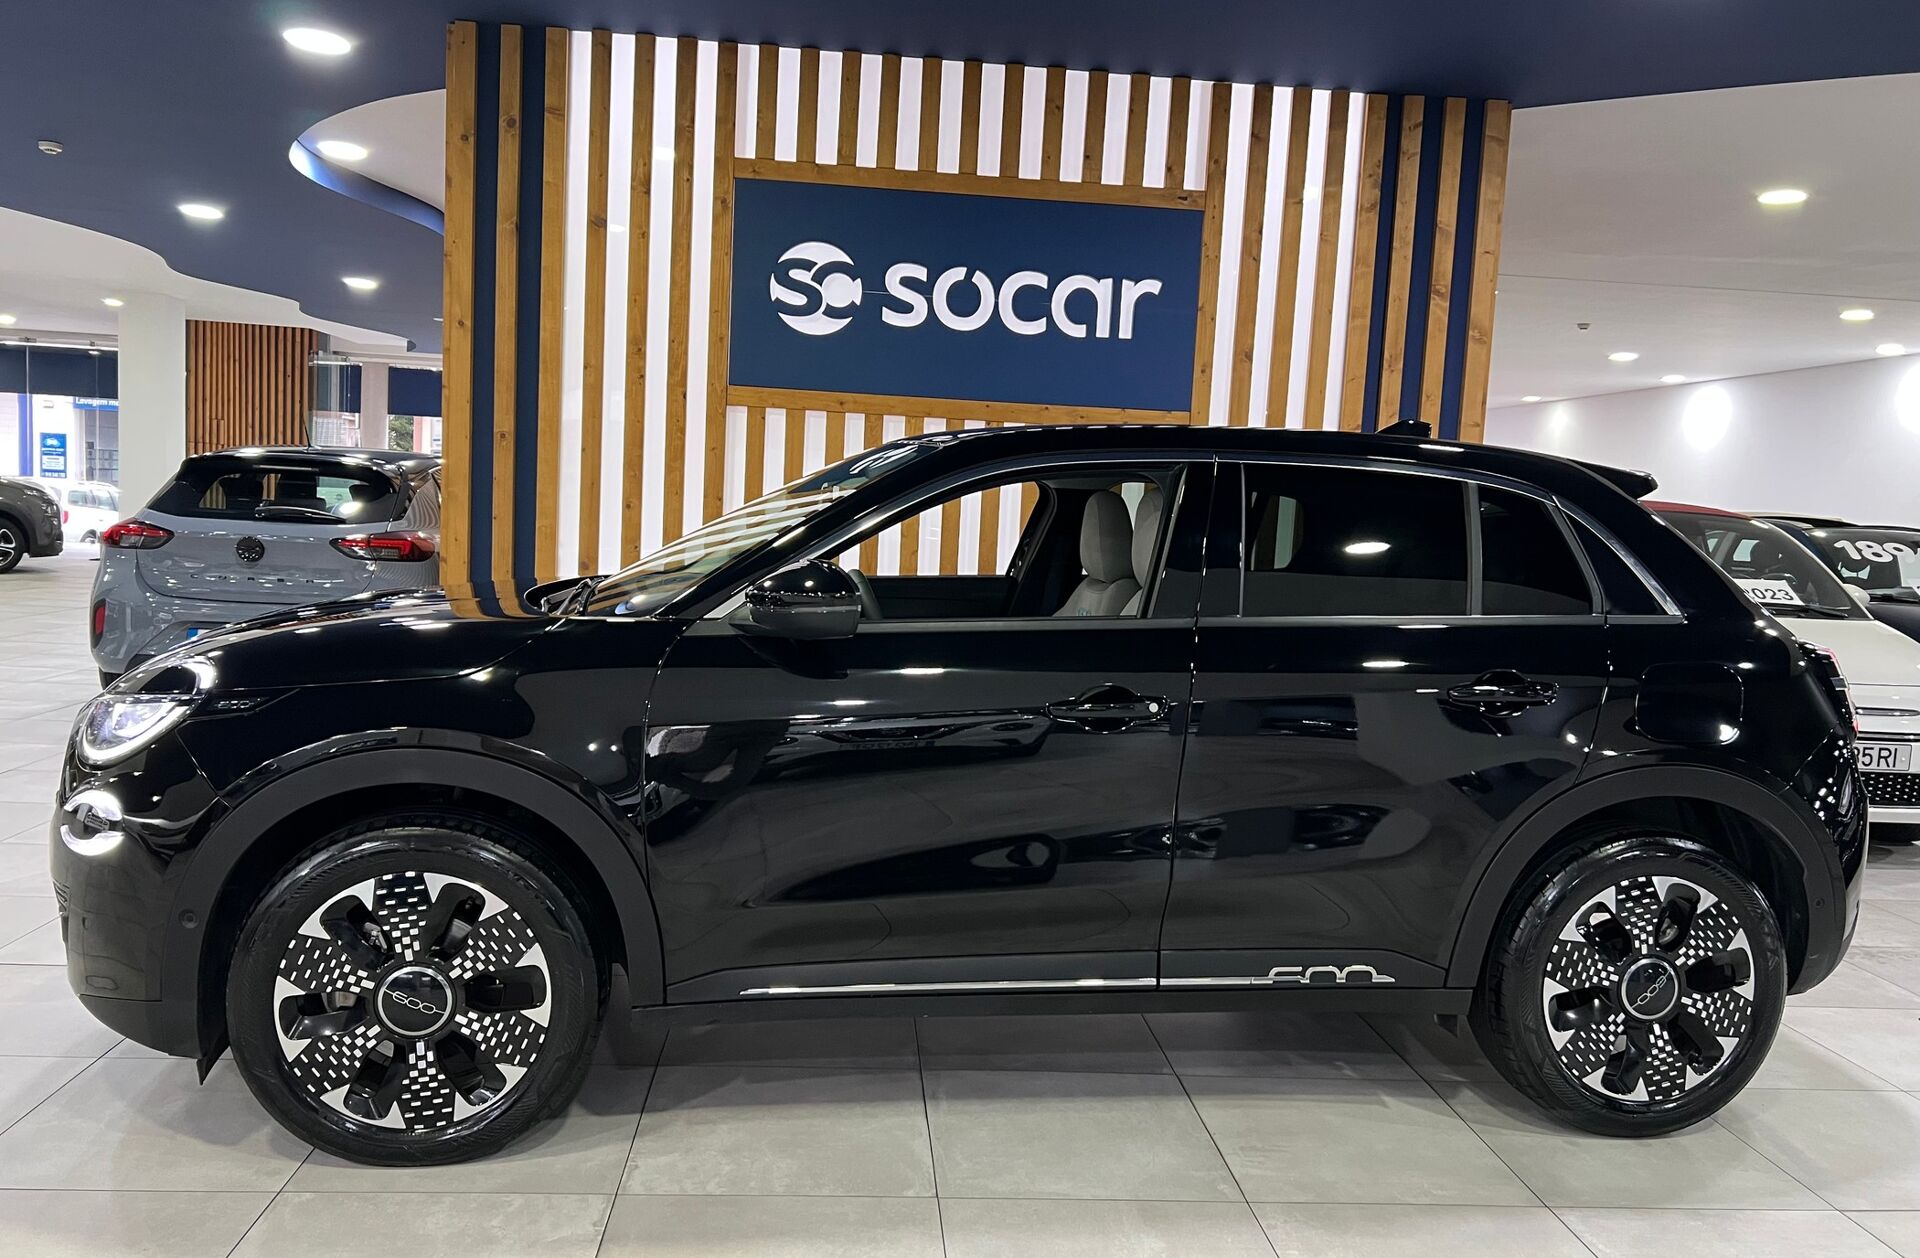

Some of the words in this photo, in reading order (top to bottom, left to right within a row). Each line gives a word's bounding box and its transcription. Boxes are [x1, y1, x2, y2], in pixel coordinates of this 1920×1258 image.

[75, 397, 108, 407] Lavagem
[1744, 588, 1794, 601] 023
[1637, 975, 1667, 1005] 600
[392, 991, 436, 1015] 600
